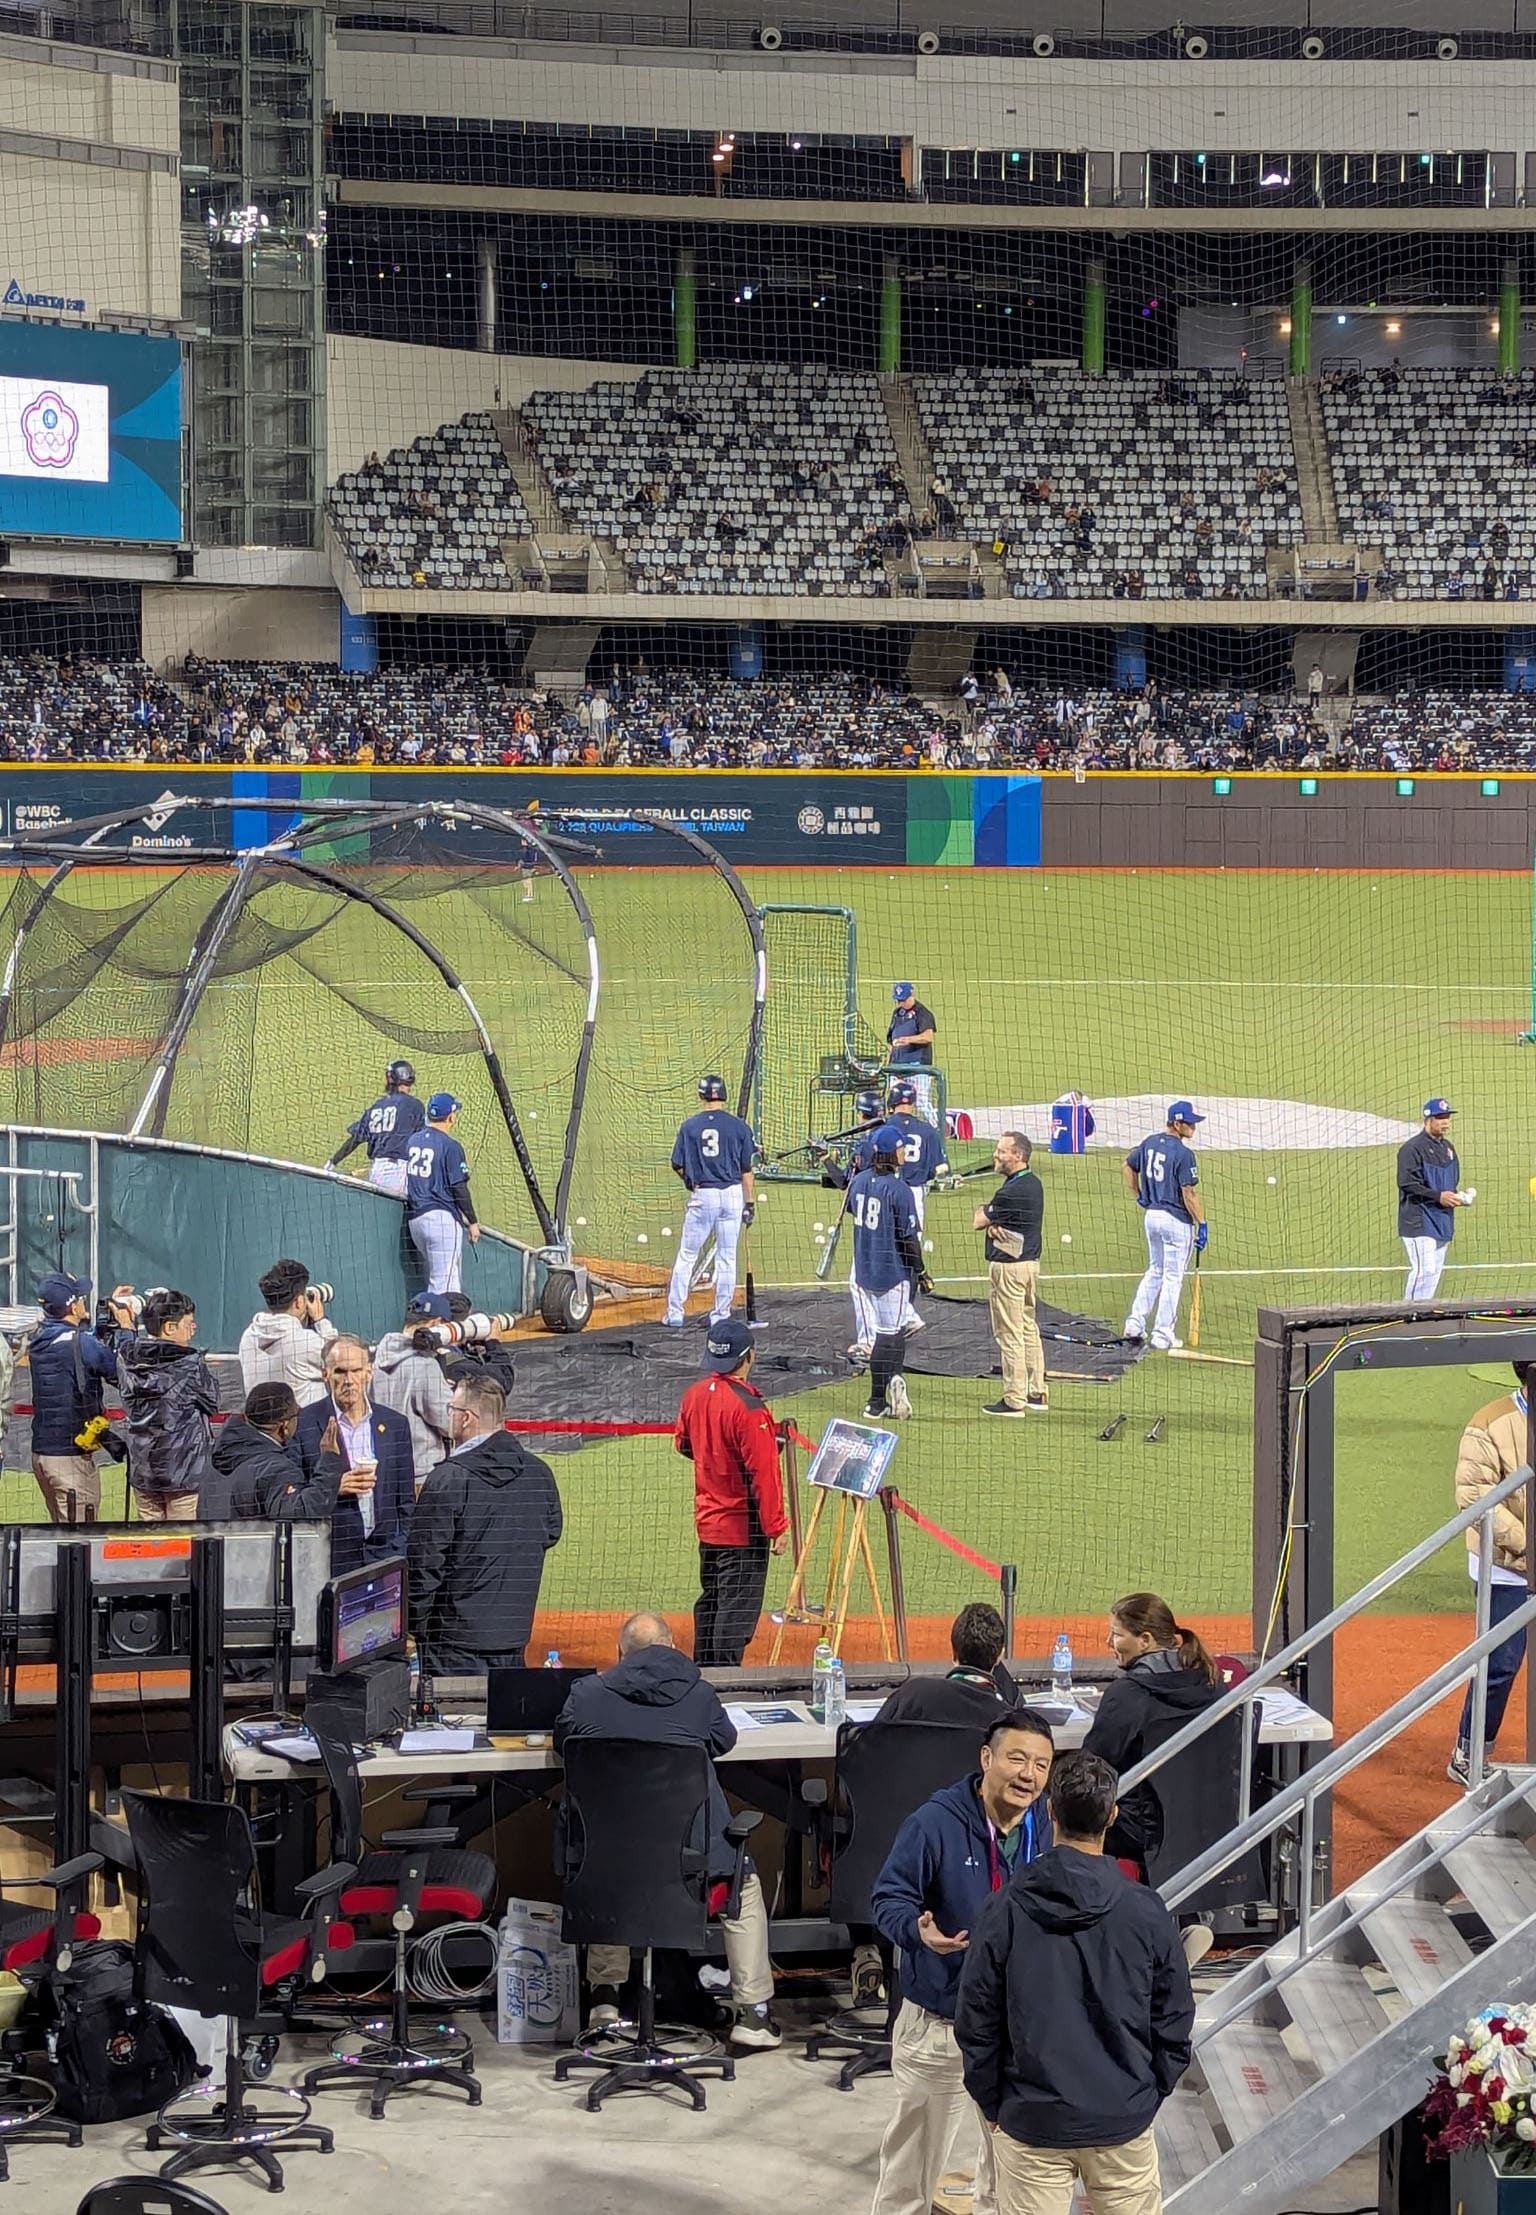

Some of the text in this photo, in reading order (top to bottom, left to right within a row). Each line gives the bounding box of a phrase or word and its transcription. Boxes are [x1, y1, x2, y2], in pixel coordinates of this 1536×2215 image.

[15, 804, 61, 818] @WBC
[690, 807, 752, 821] CLASSIC
[132, 834, 192, 848] Domino's
[368, 1105, 397, 1133] 20
[701, 1128, 720, 1157] 3
[407, 1146, 435, 1178] 23
[1146, 1149, 1166, 1182] 15
[855, 1194, 881, 1231] 18
